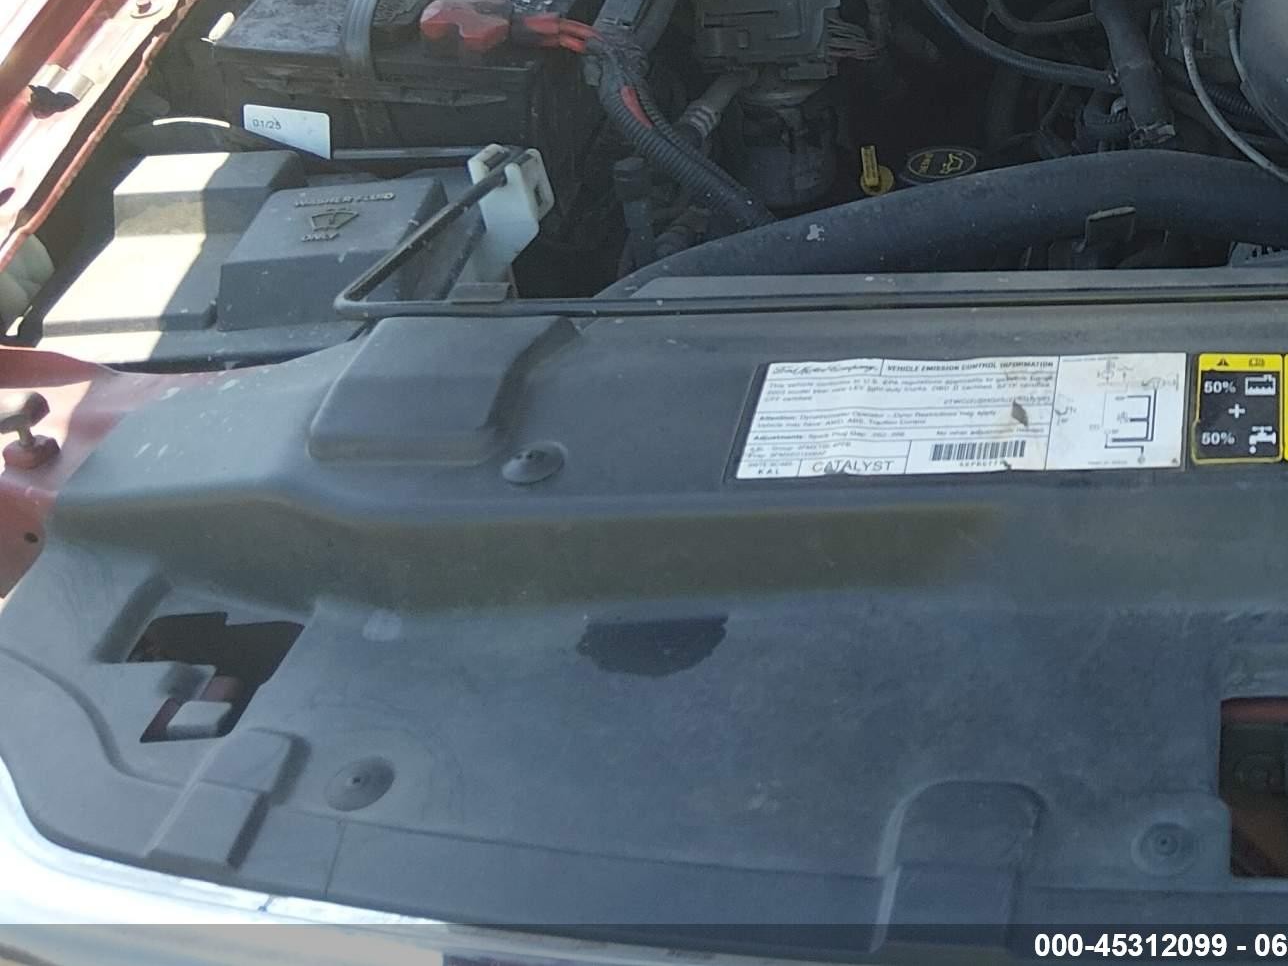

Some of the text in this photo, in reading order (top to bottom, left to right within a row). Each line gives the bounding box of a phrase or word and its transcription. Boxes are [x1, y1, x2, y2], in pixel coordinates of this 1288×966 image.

[356, 191, 395, 203] FLUID
[301, 232, 340, 243] ONLY
[1204, 380, 1236, 394] 50%
[1201, 432, 1235, 445] 50%
[812, 459, 895, 474] CATALYST
